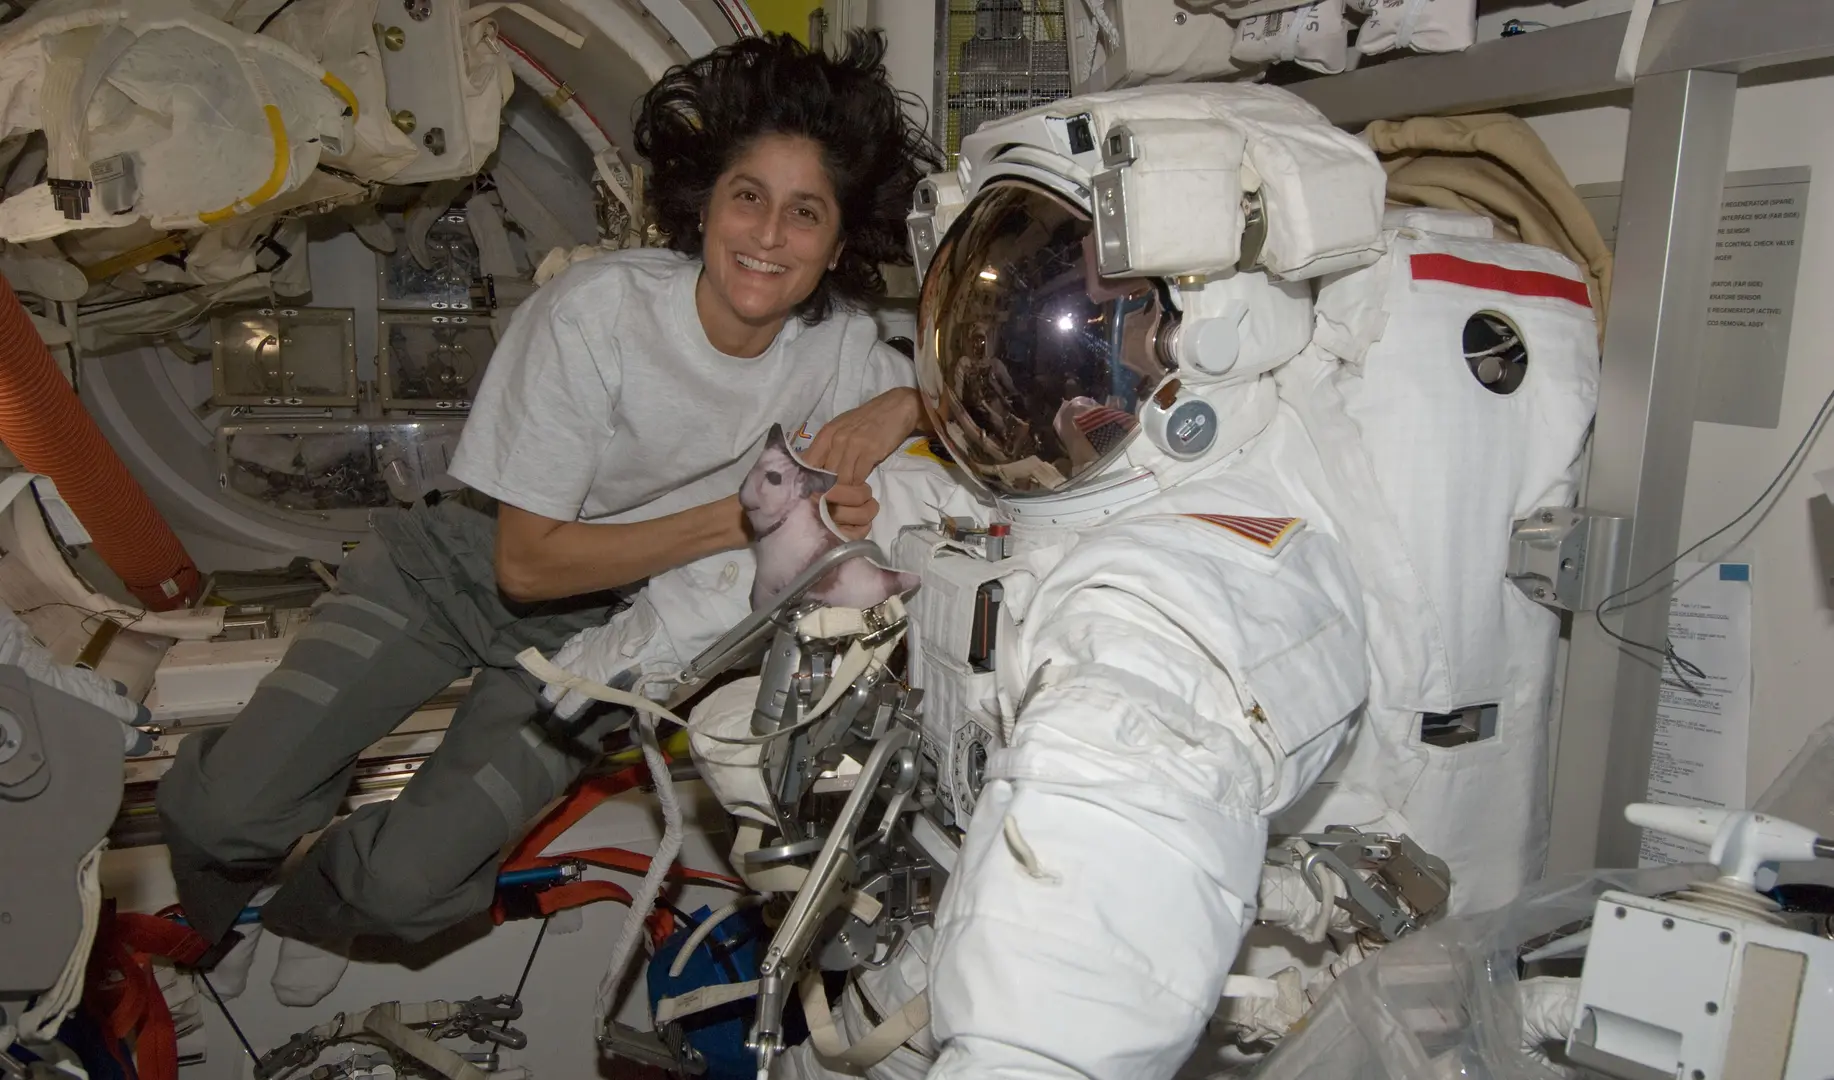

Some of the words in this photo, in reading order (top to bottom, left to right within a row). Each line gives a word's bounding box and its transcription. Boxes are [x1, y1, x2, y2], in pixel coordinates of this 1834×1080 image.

[1724, 199, 1769, 208] REGENERATOR
[1770, 198, 1795, 206] (SPARE)
[1783, 211, 1800, 219] SIDE)
